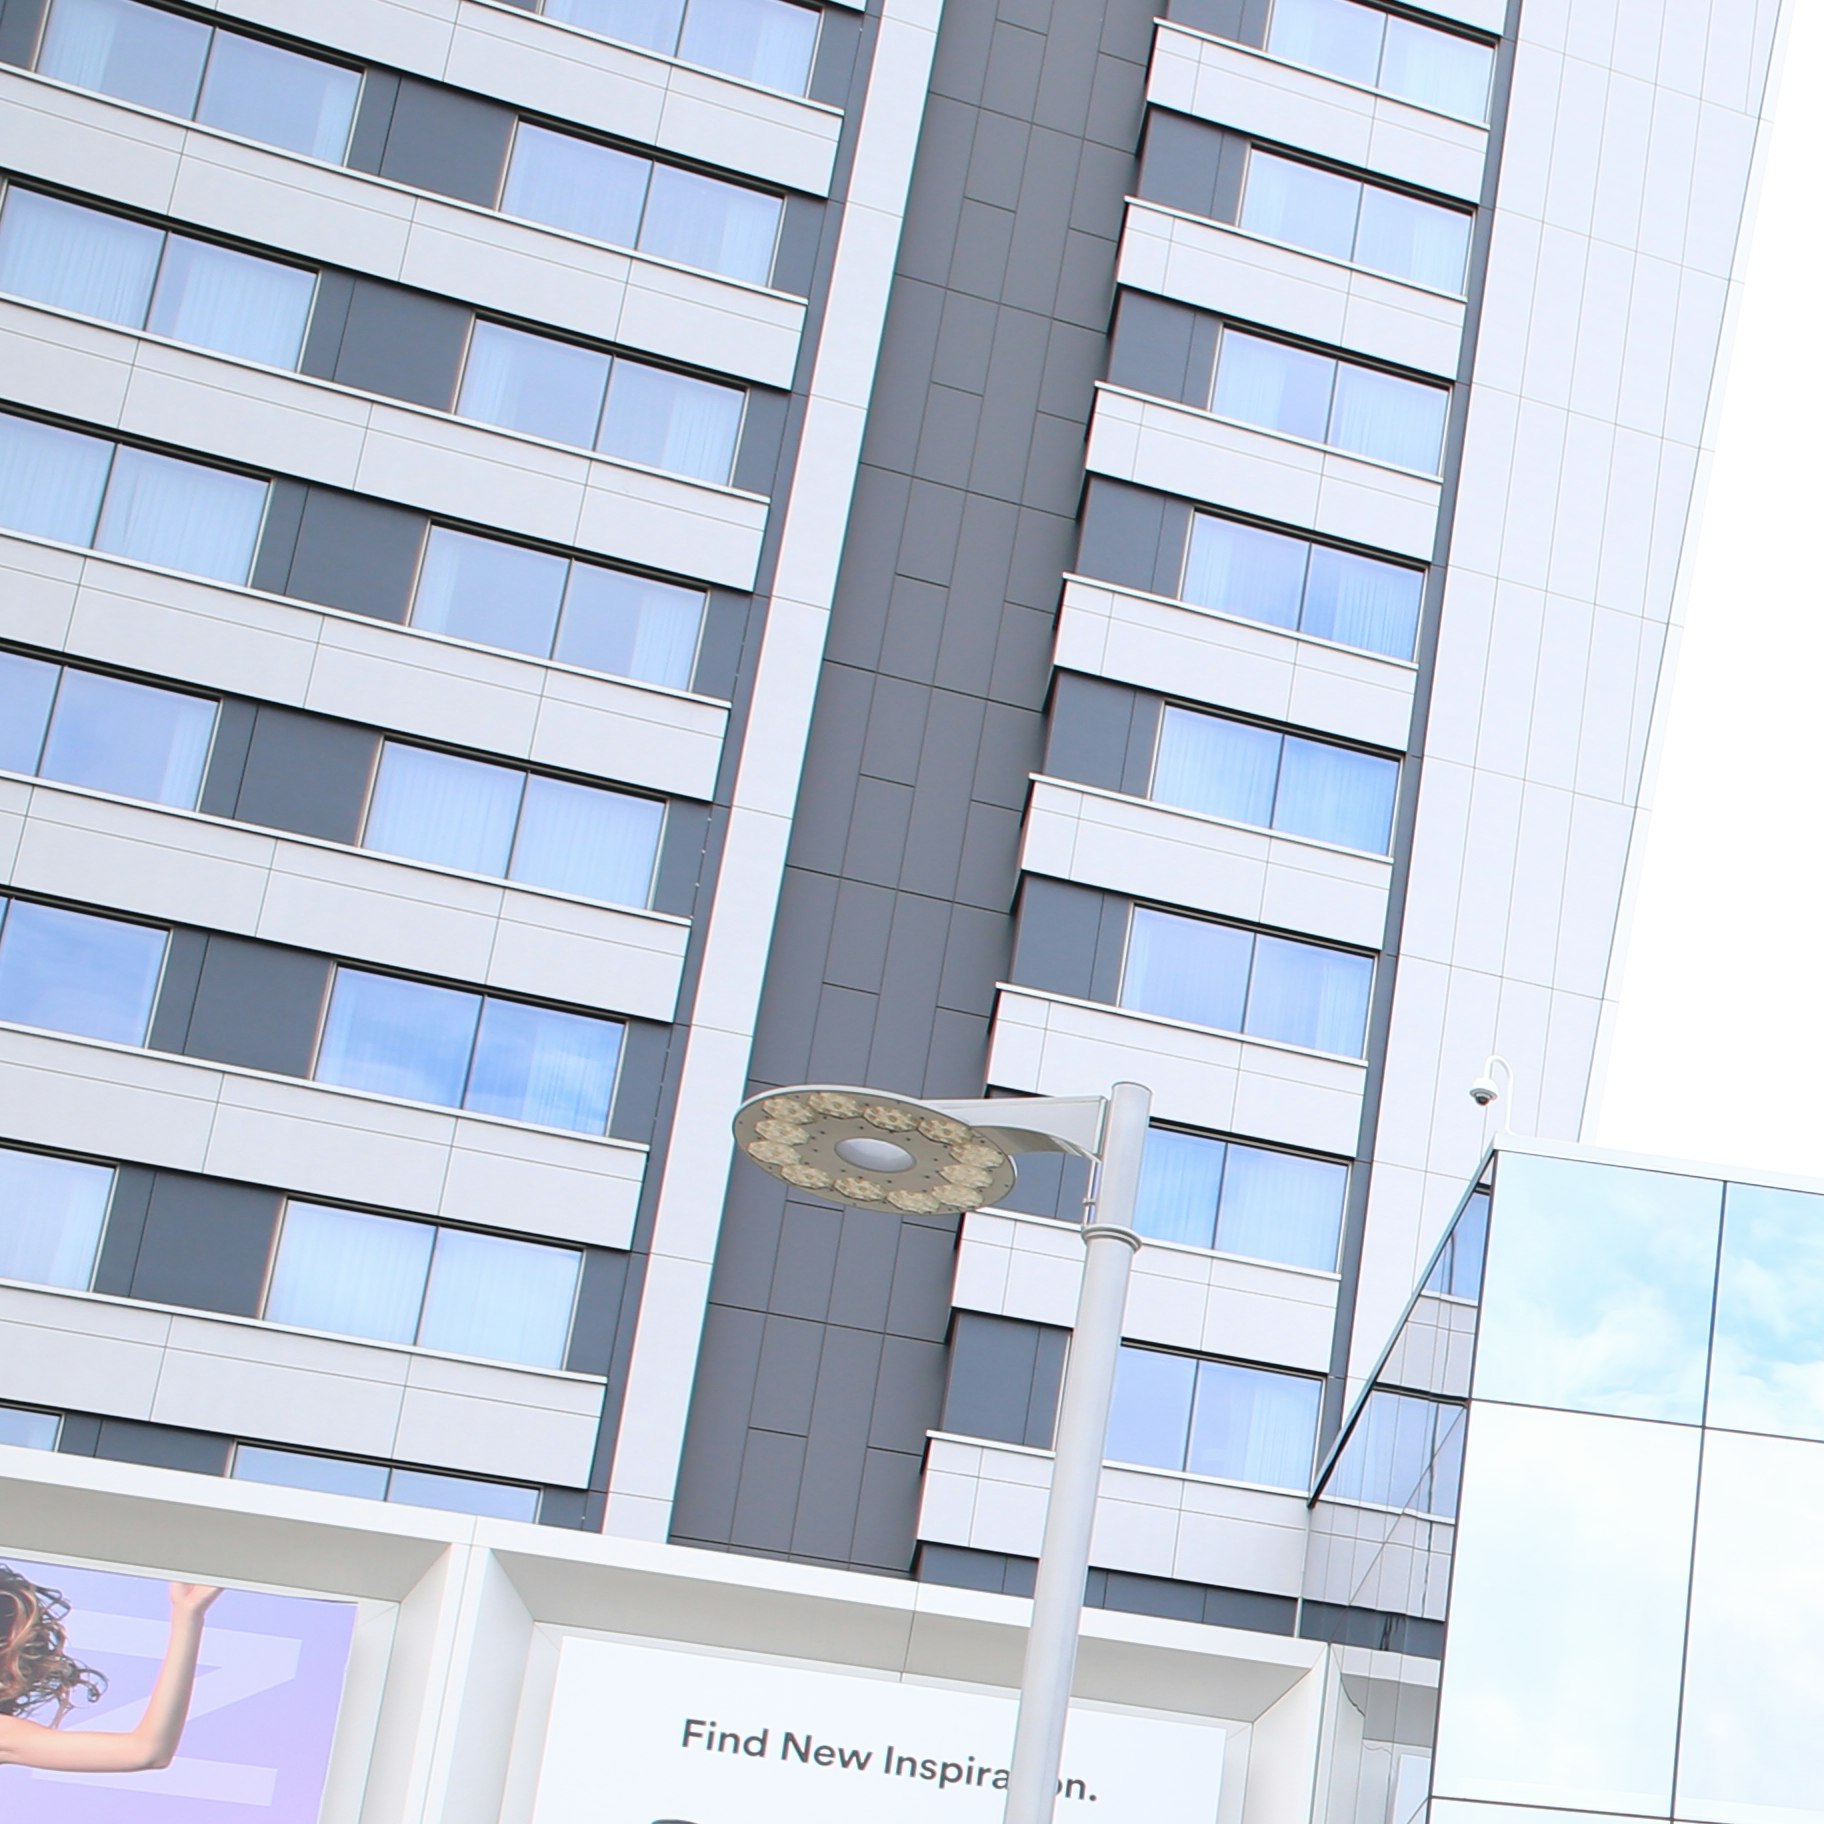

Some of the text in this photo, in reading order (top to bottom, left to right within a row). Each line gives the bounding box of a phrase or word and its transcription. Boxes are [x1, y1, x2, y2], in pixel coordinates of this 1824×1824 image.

[682, 1718, 1098, 1802] Find New Inspiran.
